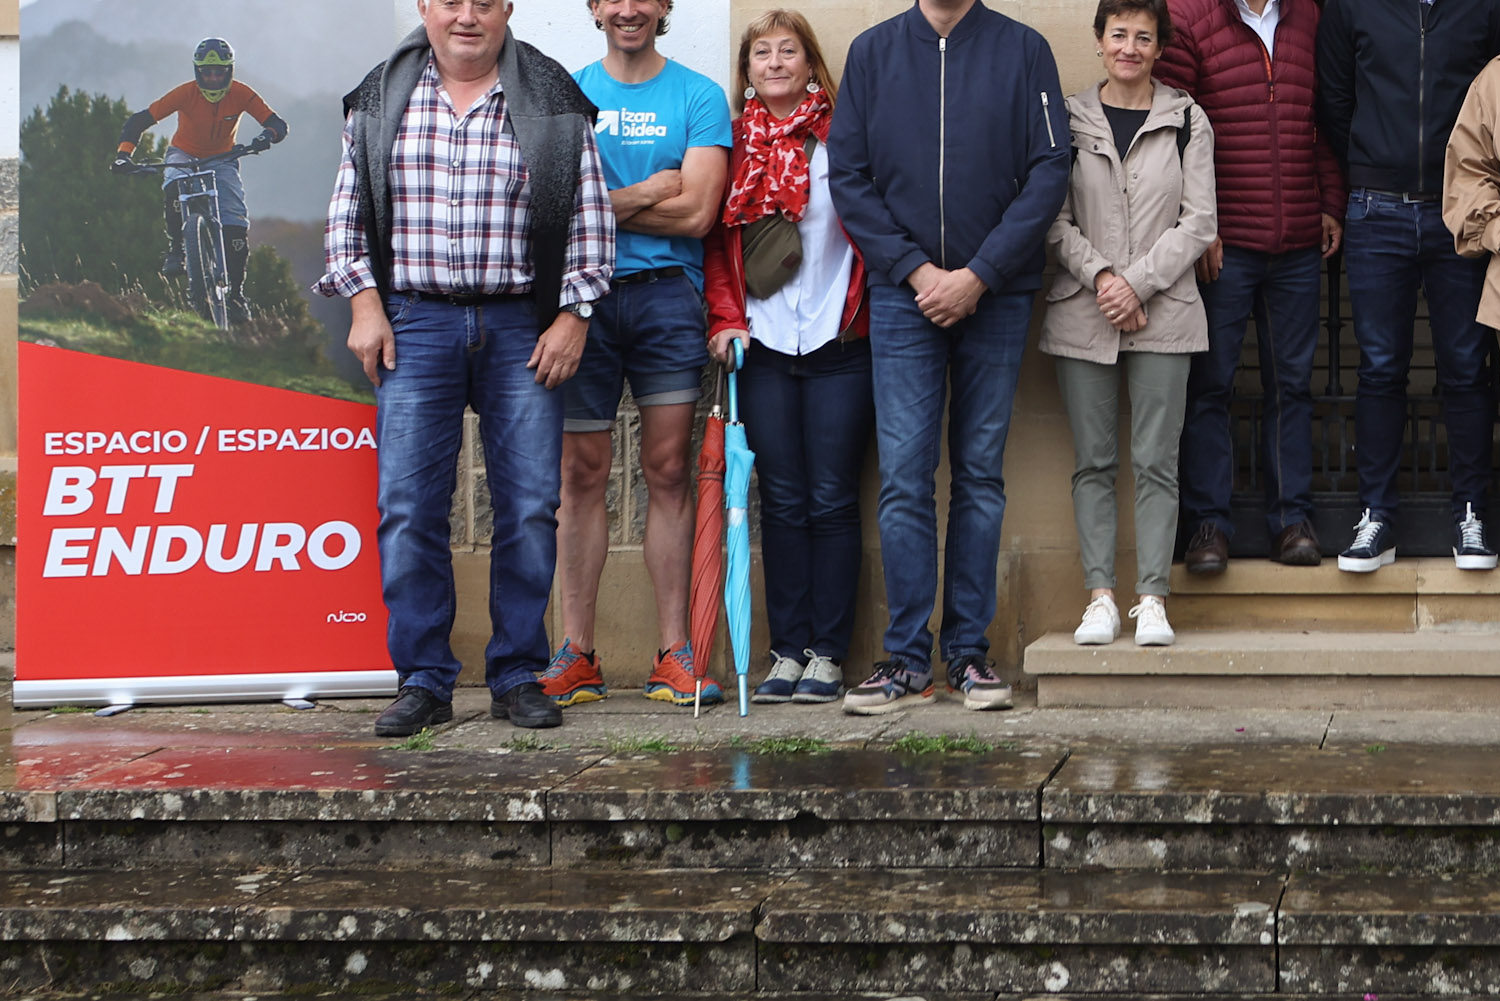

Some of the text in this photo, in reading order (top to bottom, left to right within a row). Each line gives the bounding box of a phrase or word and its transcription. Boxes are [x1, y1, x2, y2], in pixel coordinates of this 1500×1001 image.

[621, 107, 656, 123] izan
[621, 122, 667, 137] bidea
[44, 426, 377, 455] ESPACIO / ESPAZIOA
[43, 463, 194, 516] BTT
[43, 520, 362, 578] ENDURO
